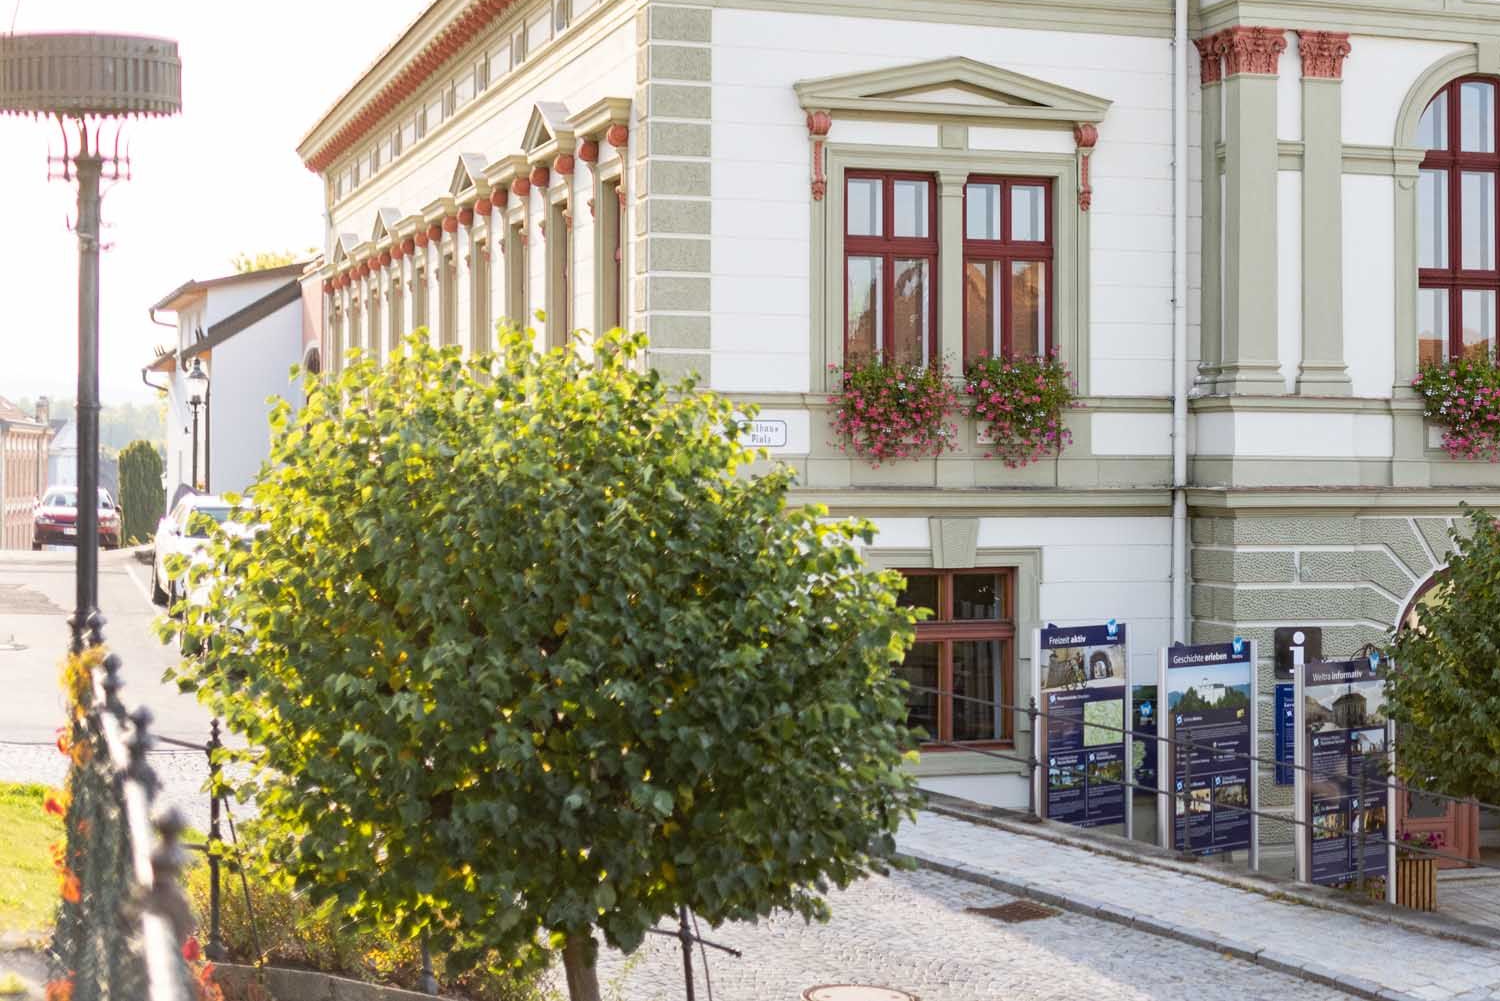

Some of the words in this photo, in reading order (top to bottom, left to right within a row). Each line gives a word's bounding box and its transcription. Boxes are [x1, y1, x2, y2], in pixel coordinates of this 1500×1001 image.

[1048, 636, 1070, 645] Freizeit
[1070, 634, 1087, 644] aktiv
[1173, 654, 1204, 664] Geschichte
[1204, 652, 1228, 662] erleben
[1331, 670, 1363, 681] informativ
